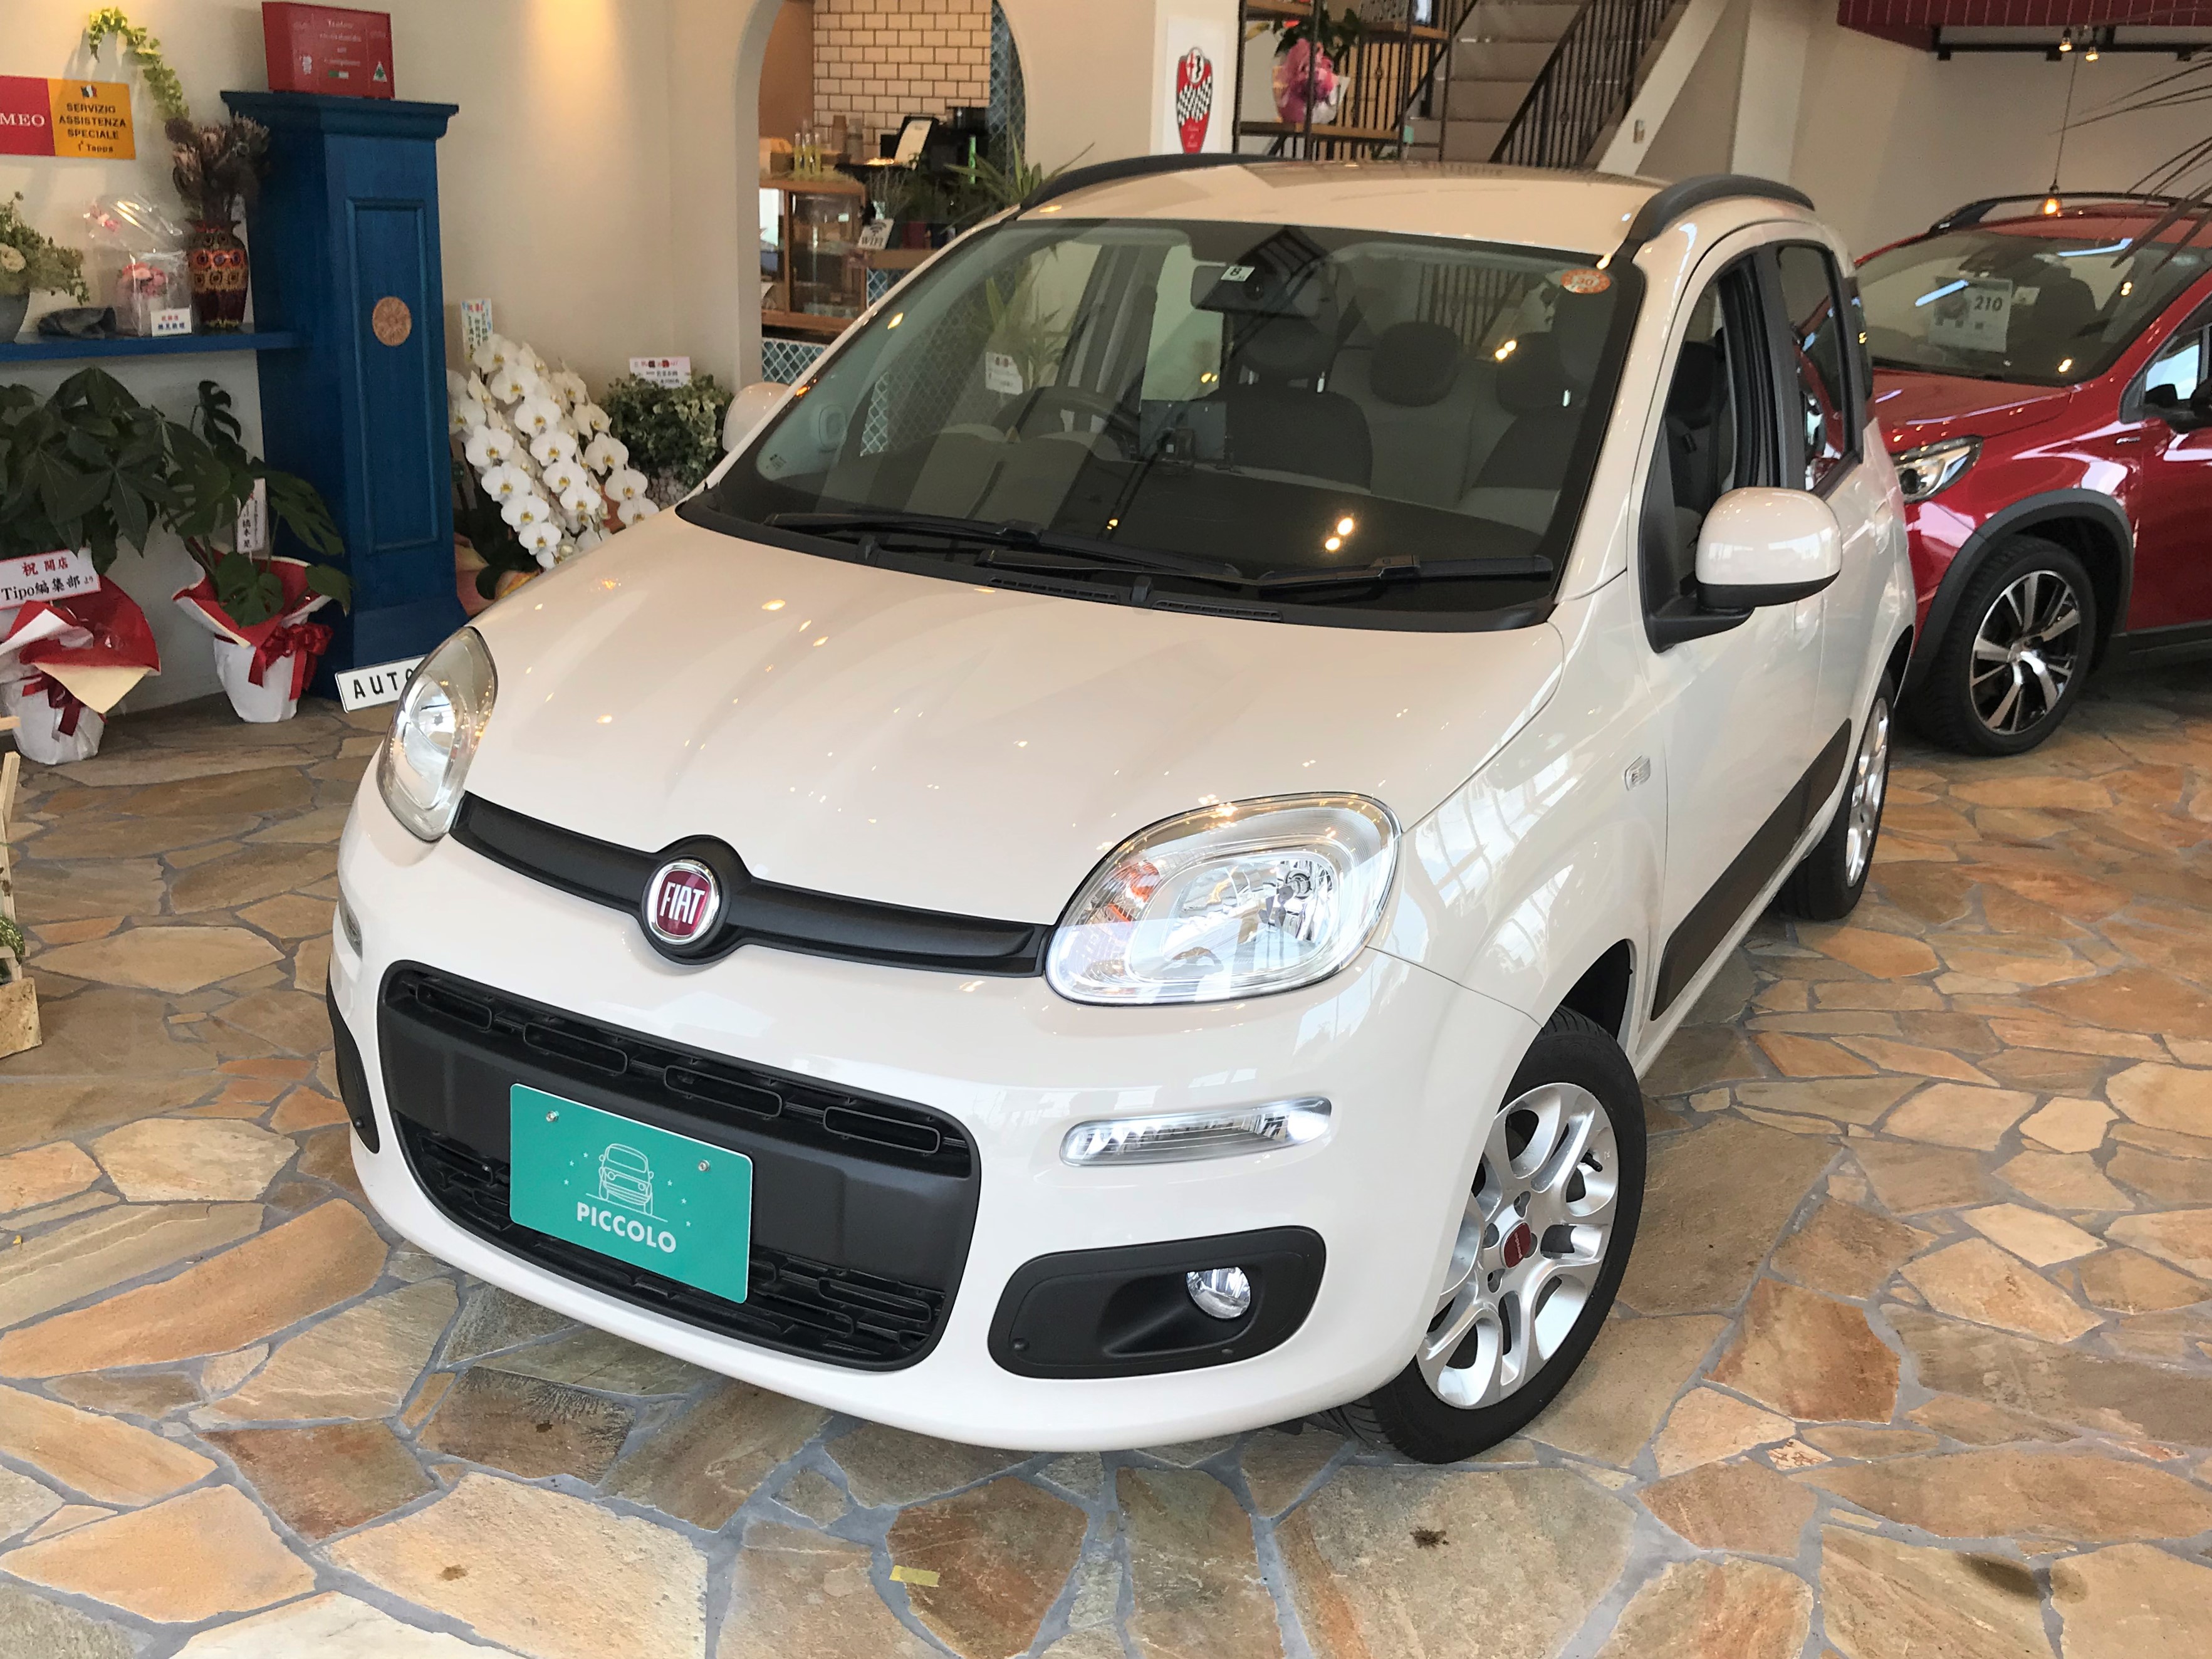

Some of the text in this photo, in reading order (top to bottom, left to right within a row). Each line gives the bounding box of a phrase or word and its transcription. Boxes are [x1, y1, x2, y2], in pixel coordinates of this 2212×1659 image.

[66, 103, 116, 113] SERVIZIO
[59, 115, 127, 128] ASSISTENZA
[67, 128, 119, 140] SPECIALE
[1975, 295, 2003, 311] 210
[659, 881, 706, 925] FIAT
[576, 1201, 677, 1253] PICCOLO
